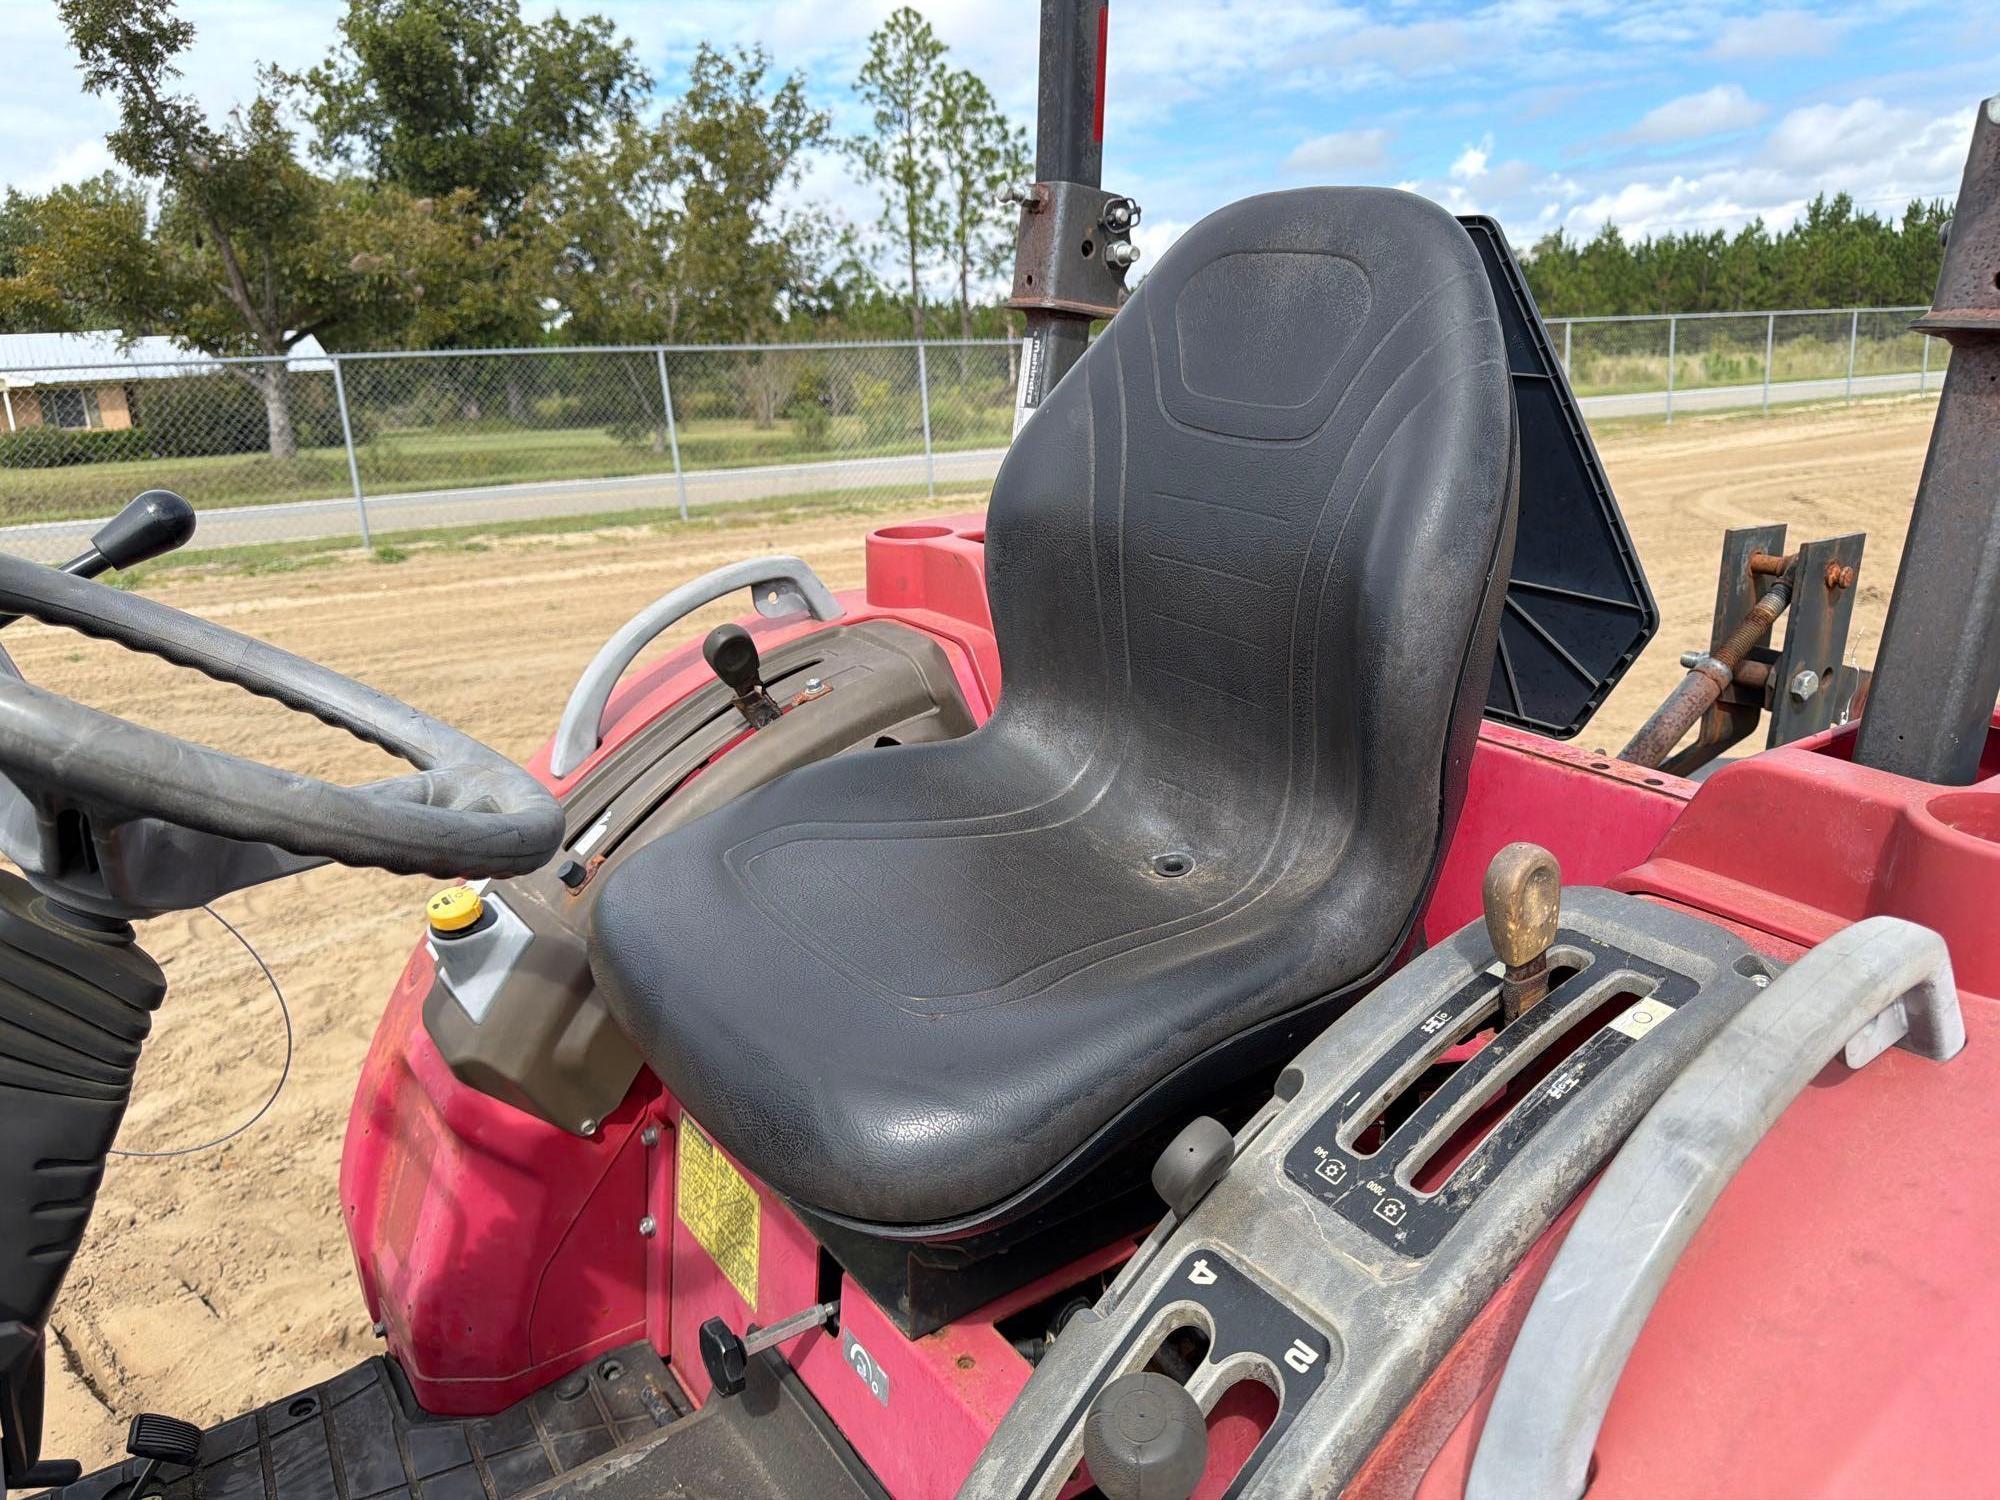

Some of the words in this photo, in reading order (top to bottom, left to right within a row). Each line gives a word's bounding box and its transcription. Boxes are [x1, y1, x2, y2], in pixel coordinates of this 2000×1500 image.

[1313, 1146, 1329, 1159] 540
[1366, 1180, 1388, 1196] 2000
[1187, 1258, 1218, 1286] 4
[1283, 1338, 1320, 1374] 2
